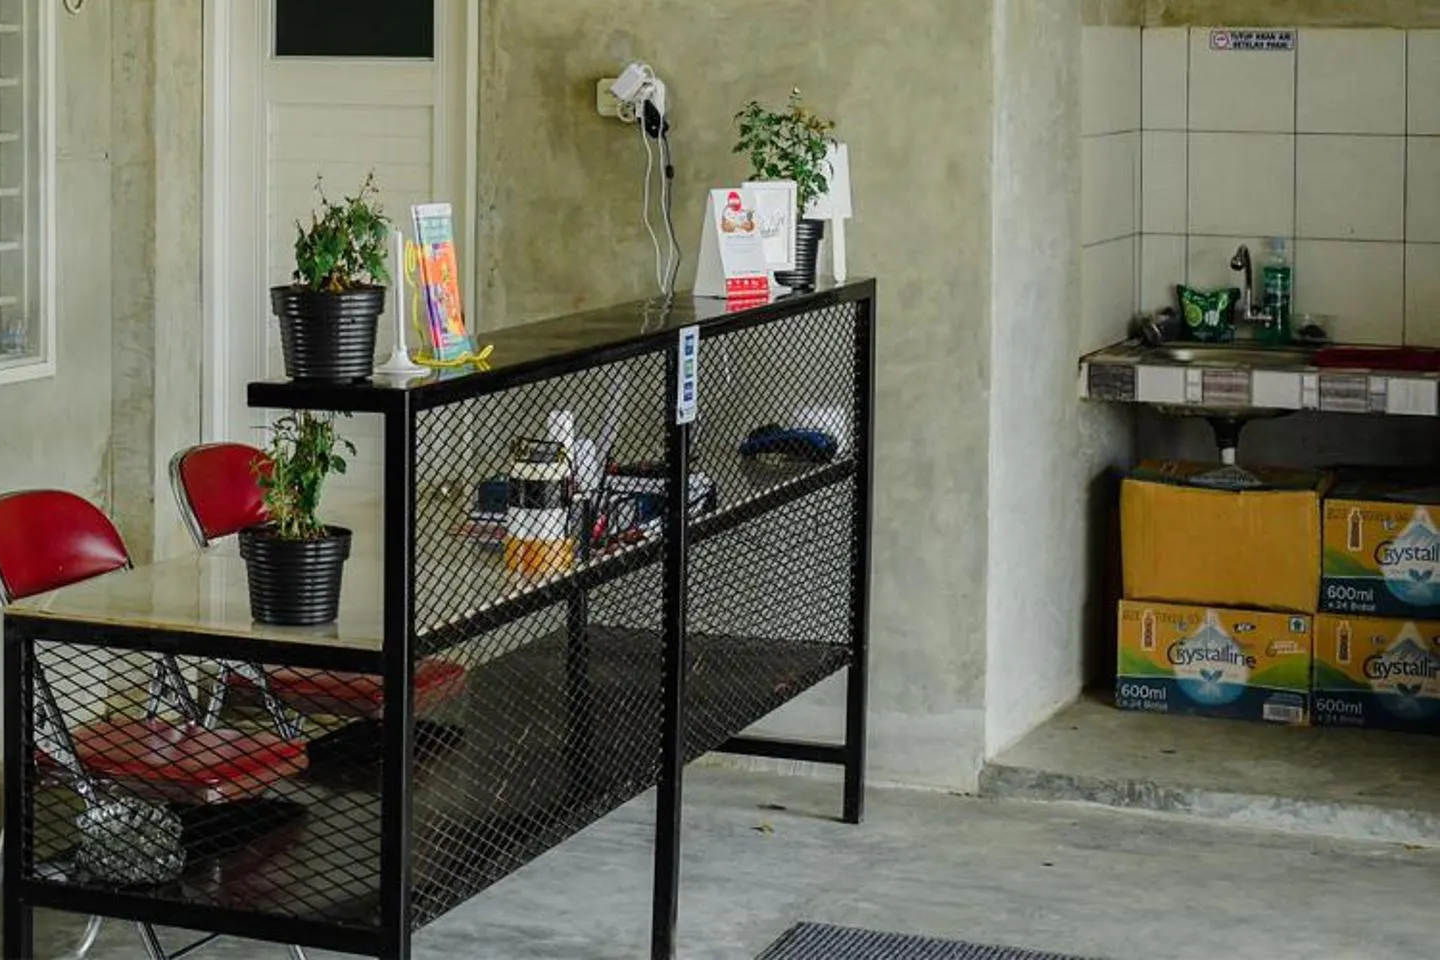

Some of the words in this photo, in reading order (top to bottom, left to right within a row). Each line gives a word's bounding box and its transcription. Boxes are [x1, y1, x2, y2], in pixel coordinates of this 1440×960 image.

[1326, 585, 1374, 601] 600ml
[1166, 638, 1257, 670] Crystalline
[1120, 683, 1167, 701] 600ml
[1316, 699, 1363, 715] 600ml
